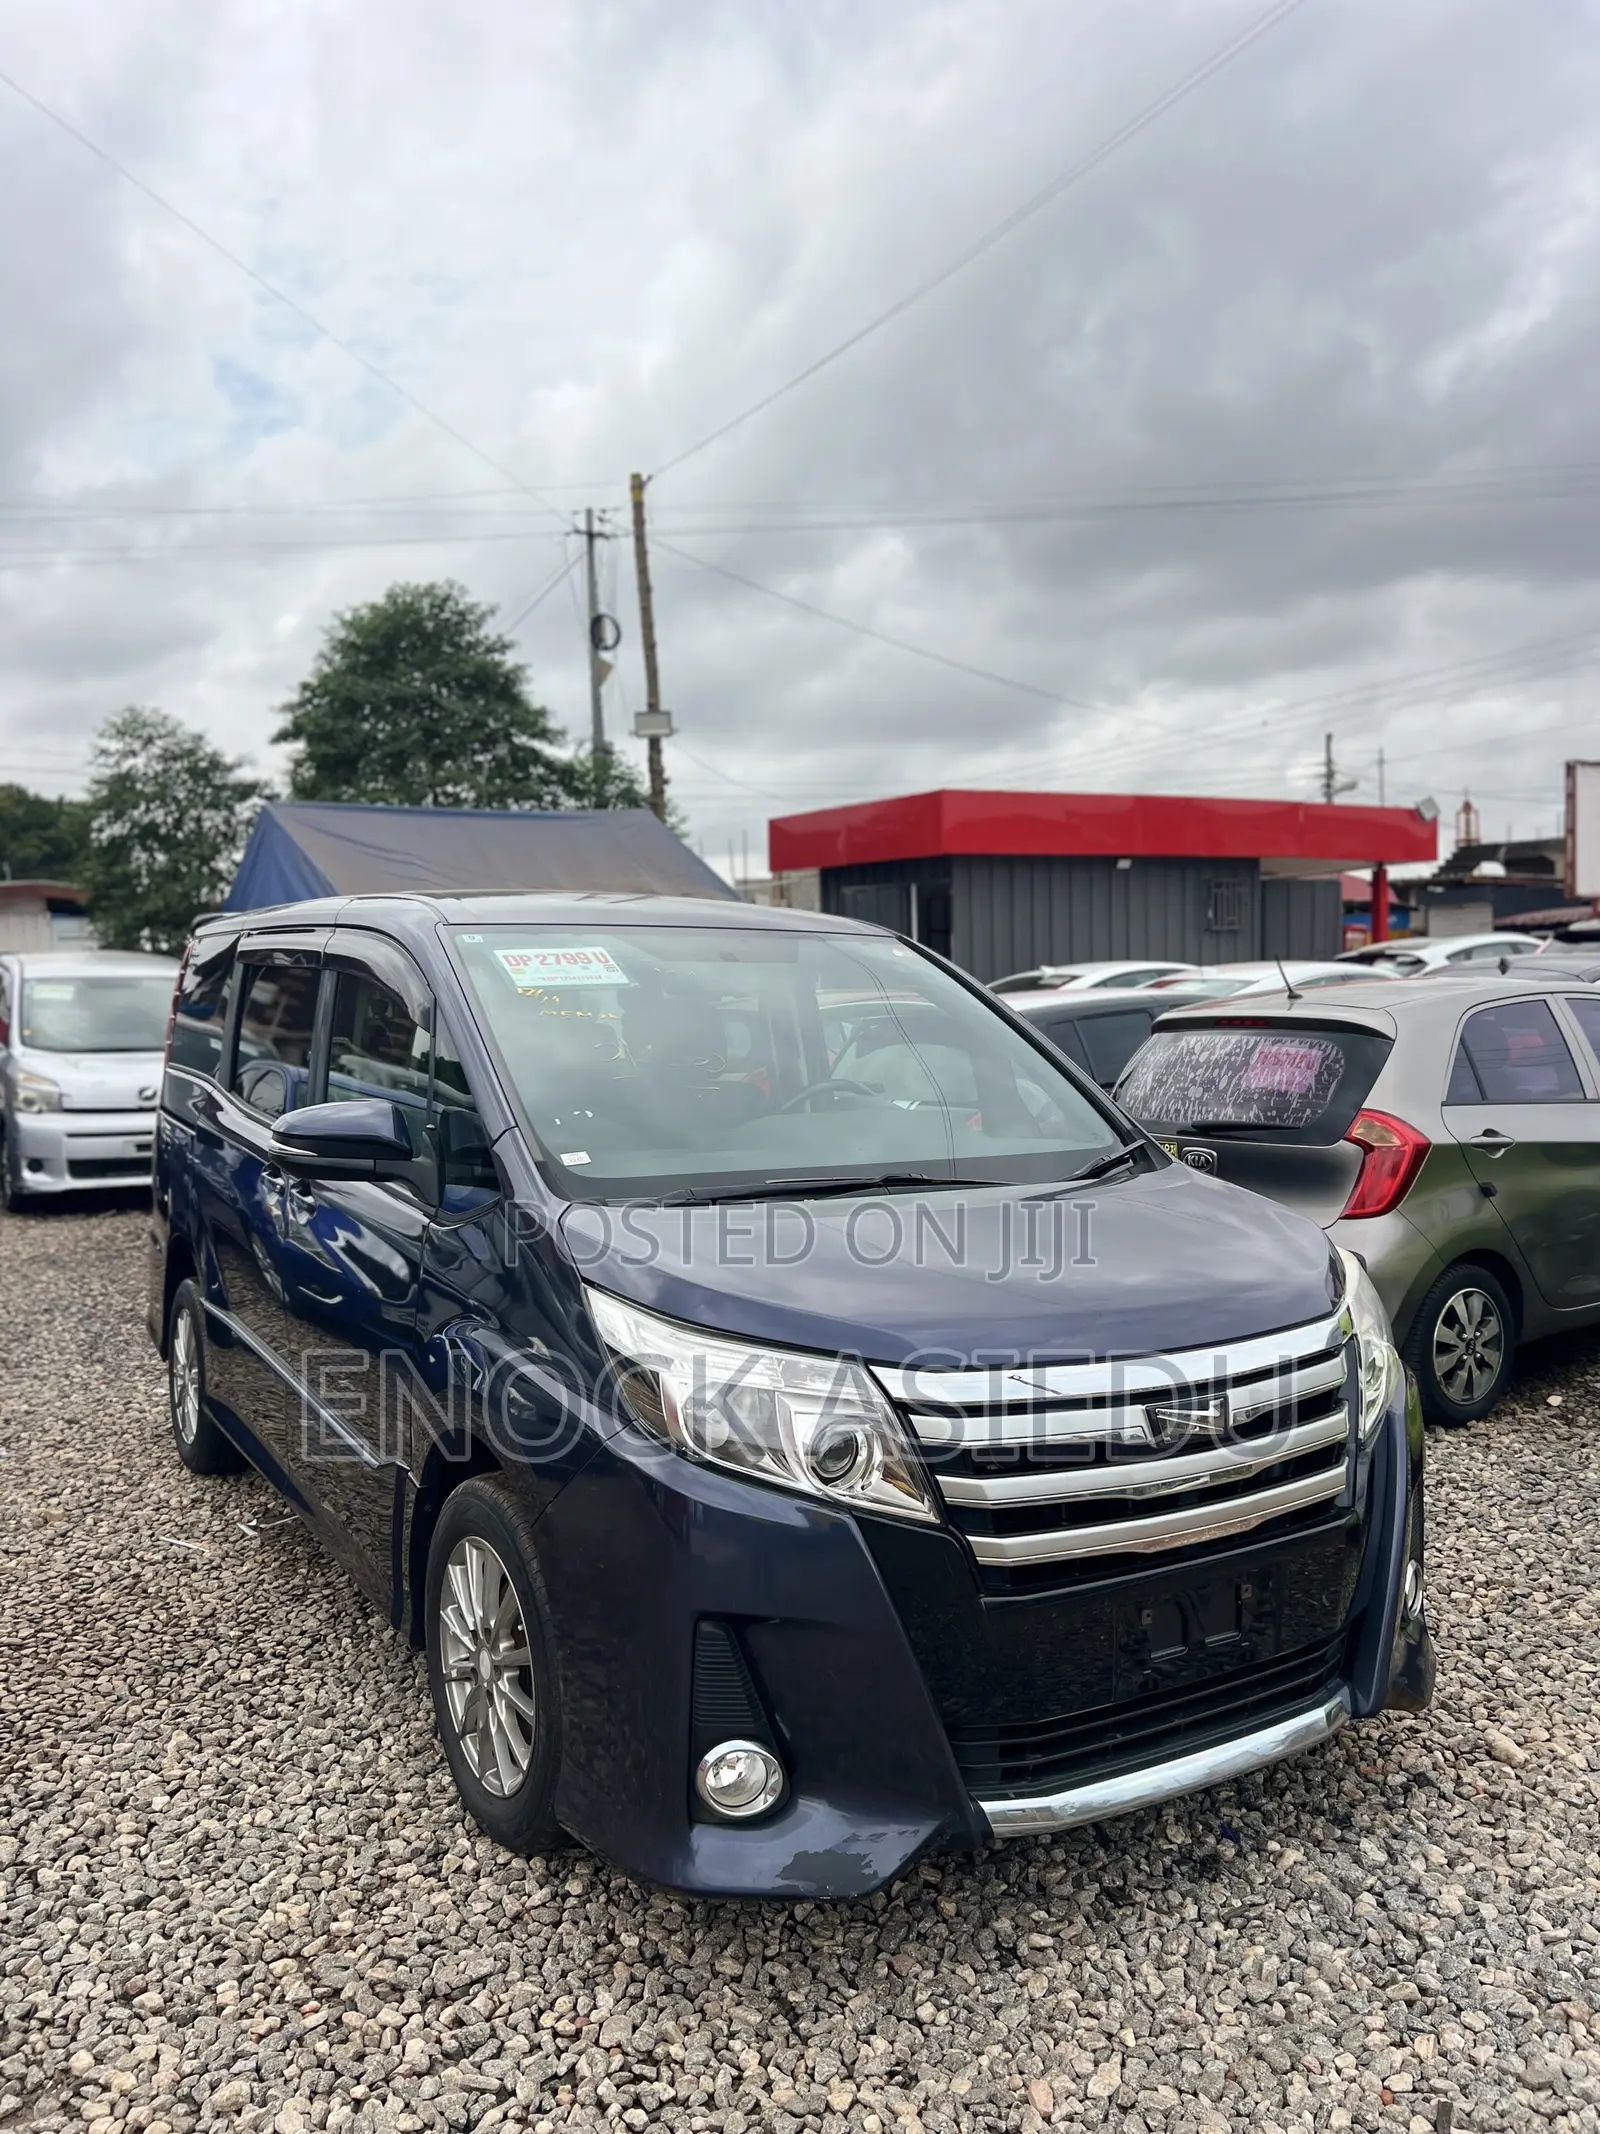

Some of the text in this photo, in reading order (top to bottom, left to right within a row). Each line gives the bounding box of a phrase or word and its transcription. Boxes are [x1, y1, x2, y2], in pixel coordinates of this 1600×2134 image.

[503, 951, 611, 967] DP 2799 U
[1187, 1154, 1207, 1167] KIA
